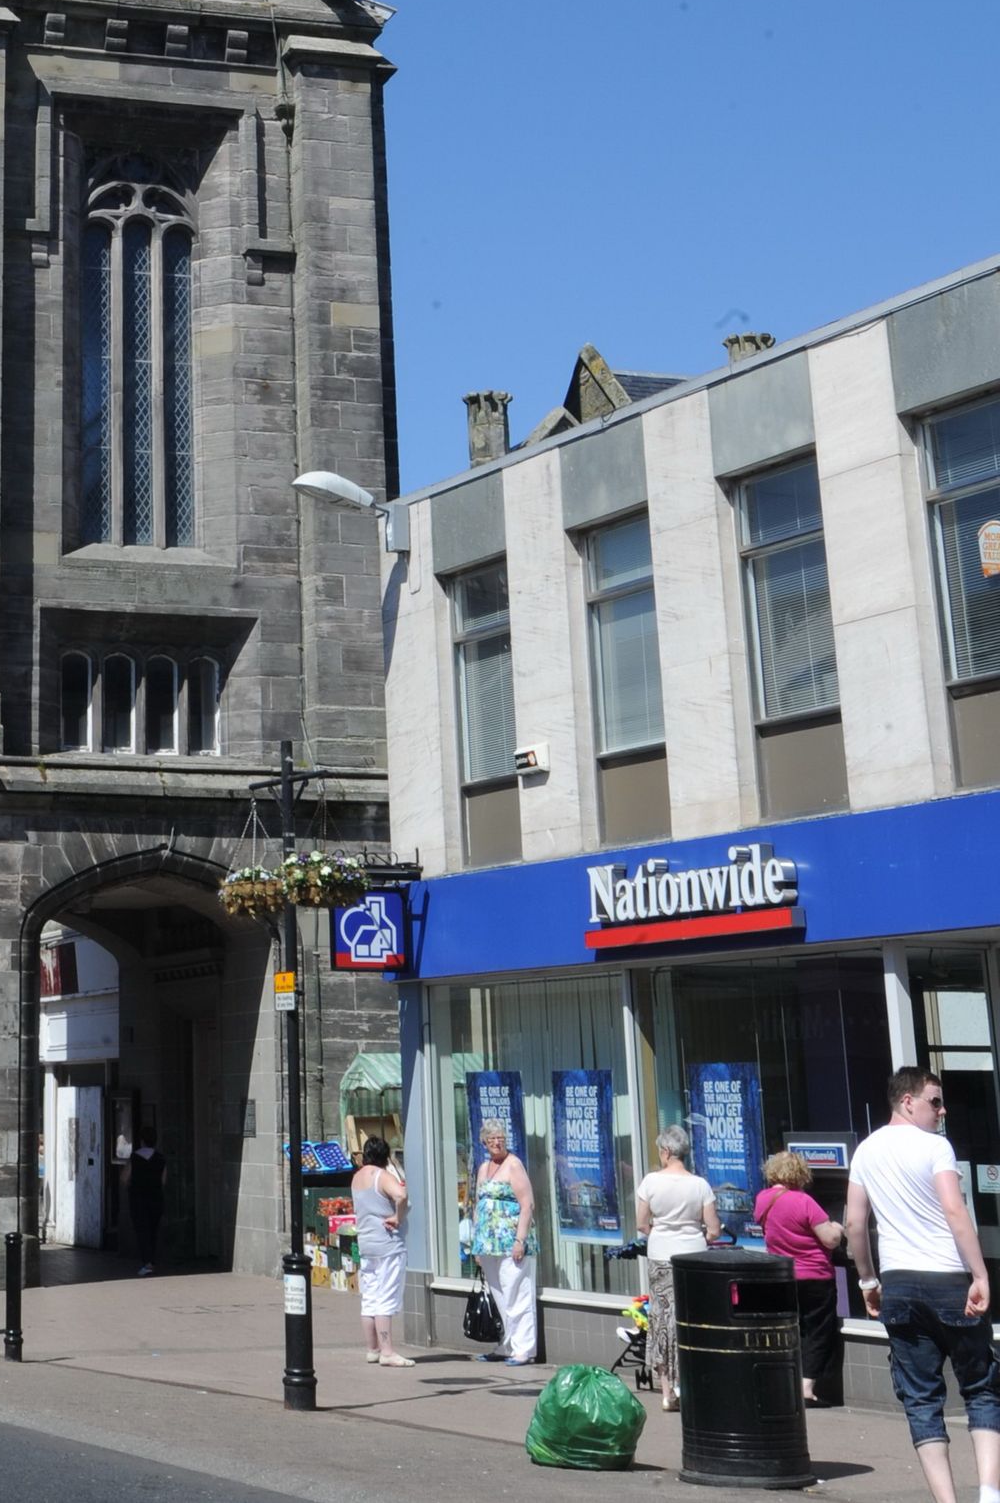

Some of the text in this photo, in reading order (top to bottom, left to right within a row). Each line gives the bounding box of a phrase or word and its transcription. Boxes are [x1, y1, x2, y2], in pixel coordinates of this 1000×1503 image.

[586, 843, 786, 923] Nationwide
[479, 1086, 510, 1098] BE ONE OF
[565, 1085, 598, 1098] BE ONE OF
[703, 1080, 741, 1093] BE ONE OF
[565, 1097, 598, 1106] THE MILLIONS
[704, 1093, 742, 1103] THE MILLIONS
[480, 1106, 511, 1118] WHO GET
[566, 1106, 598, 1119] WHO GET
[704, 1103, 742, 1116] WHO GET
[566, 1119, 599, 1140] MORE
[705, 1117, 743, 1139] MORE
[567, 1140, 599, 1153] FOR FREE
[707, 1139, 744, 1153] FOR FREE
